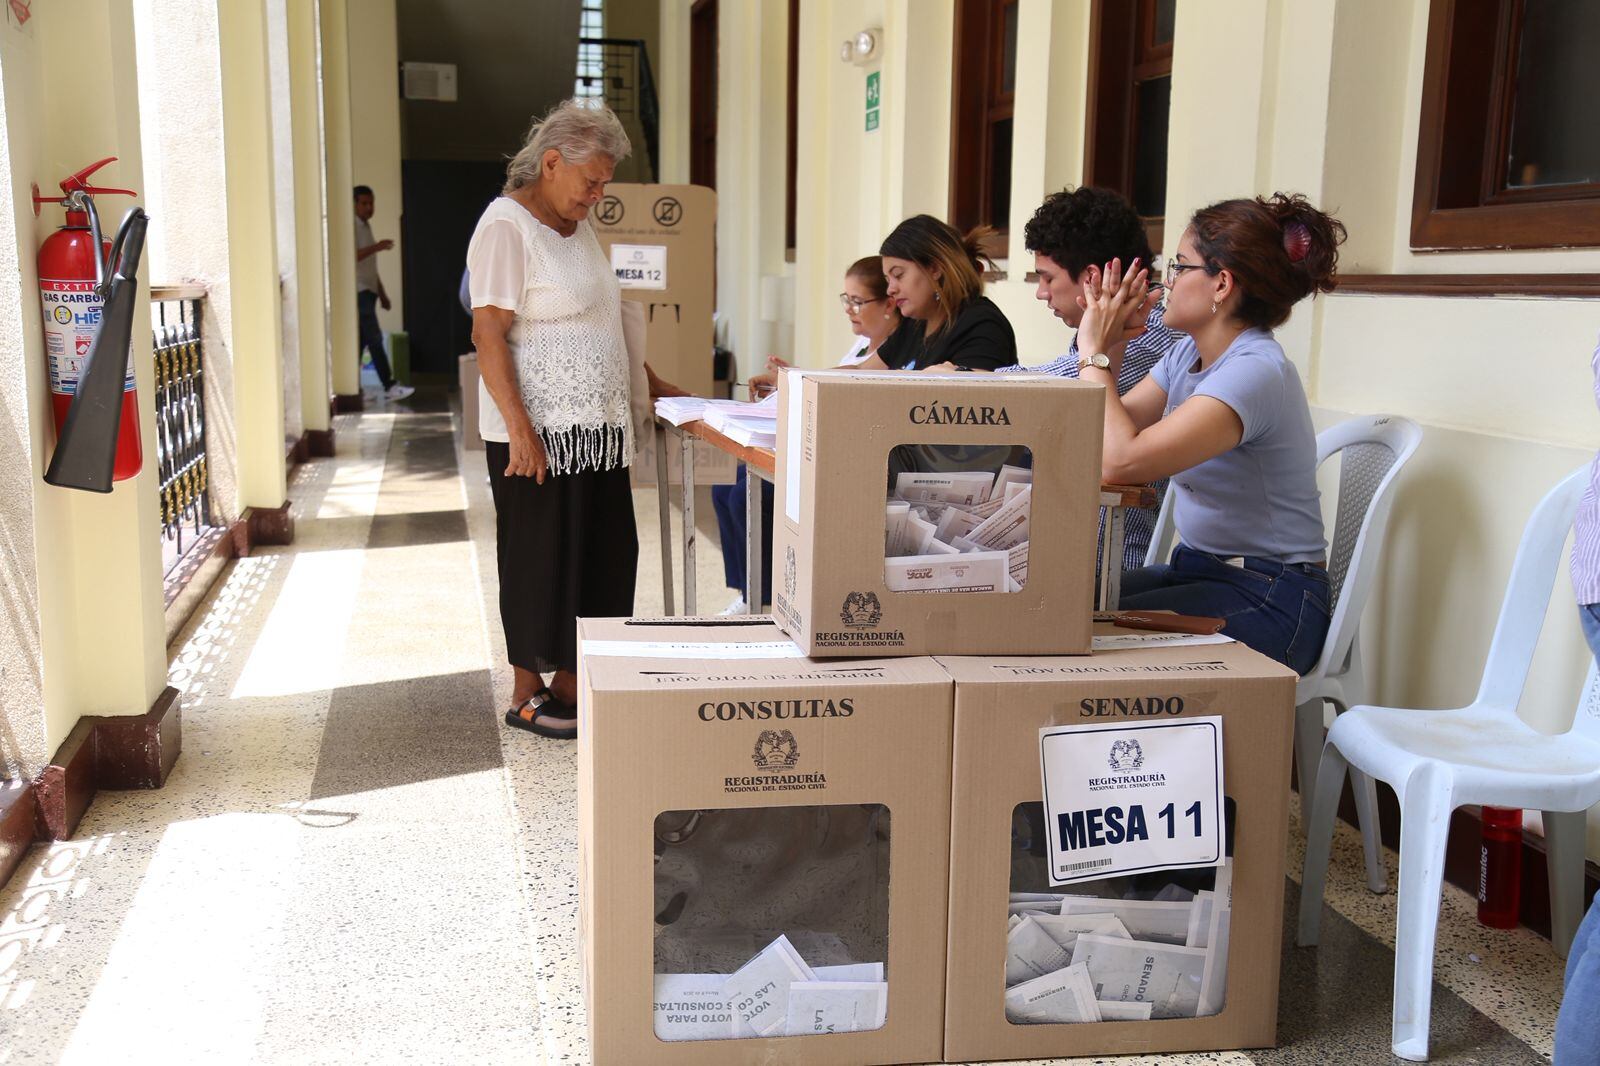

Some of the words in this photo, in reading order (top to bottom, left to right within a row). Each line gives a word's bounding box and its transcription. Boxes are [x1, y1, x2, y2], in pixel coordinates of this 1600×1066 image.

[615, 269, 644, 281] MESA
[647, 270, 661, 281] 12
[43, 293, 59, 303] GAS
[909, 401, 1011, 426] CÁMARA
[815, 629, 905, 641] REGISTRADURÍA
[698, 698, 854, 722] CONSULTAS
[1079, 696, 1184, 718] SENADO
[724, 771, 826, 786] REGISTRADURÍA
[1088, 772, 1166, 787] REGISTRADURÍA
[1057, 804, 1149, 852] MESA
[1134, 956, 1155, 1001] SENADO
[754, 981, 776, 999] LAS
[653, 1002, 723, 1011] CONSULTAS
[666, 1014, 698, 1023] PARA
[702, 1014, 732, 1023] VOTO
[814, 1009, 823, 1031] LAS
